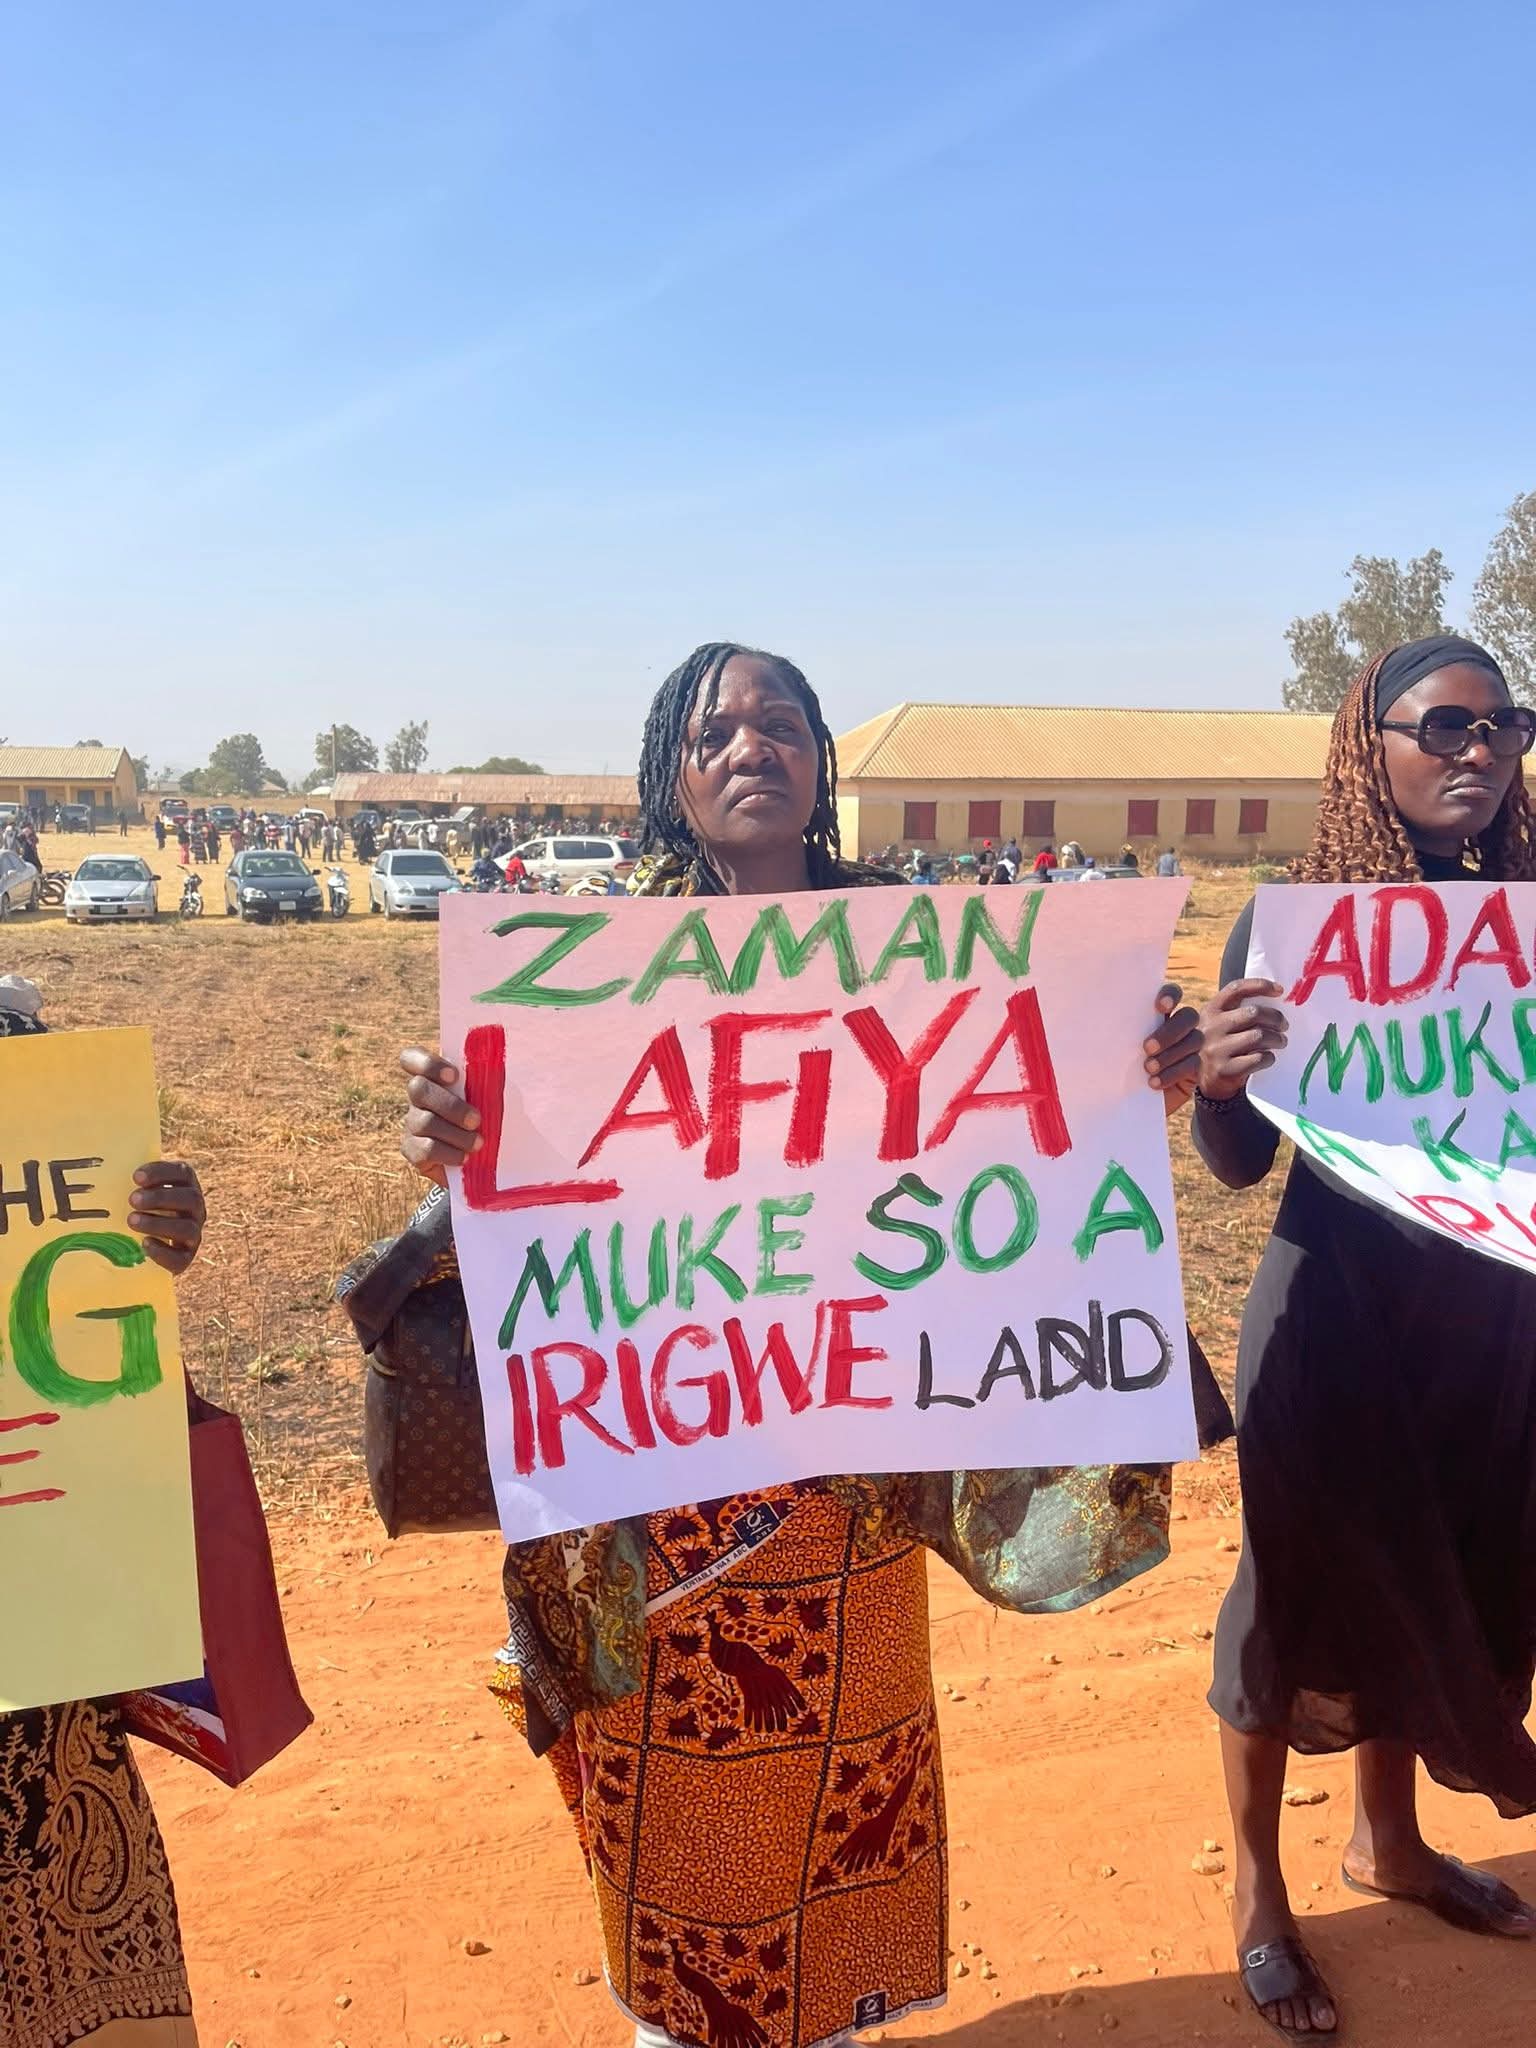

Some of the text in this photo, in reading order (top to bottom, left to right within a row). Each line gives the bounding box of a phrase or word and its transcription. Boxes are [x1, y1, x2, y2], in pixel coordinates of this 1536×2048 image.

[471, 889, 1043, 1008] ZAMAN
[1284, 885, 1536, 1006] ADA
[460, 986, 1073, 1212] LAFIYA
[1295, 1112, 1381, 1177] A
[498, 1160, 1164, 1350] MUKE SO A
[506, 1295, 893, 1476] IRIGWE
[714, 1557, 731, 1571] WAX
[732, 1544, 748, 1560] ABC
